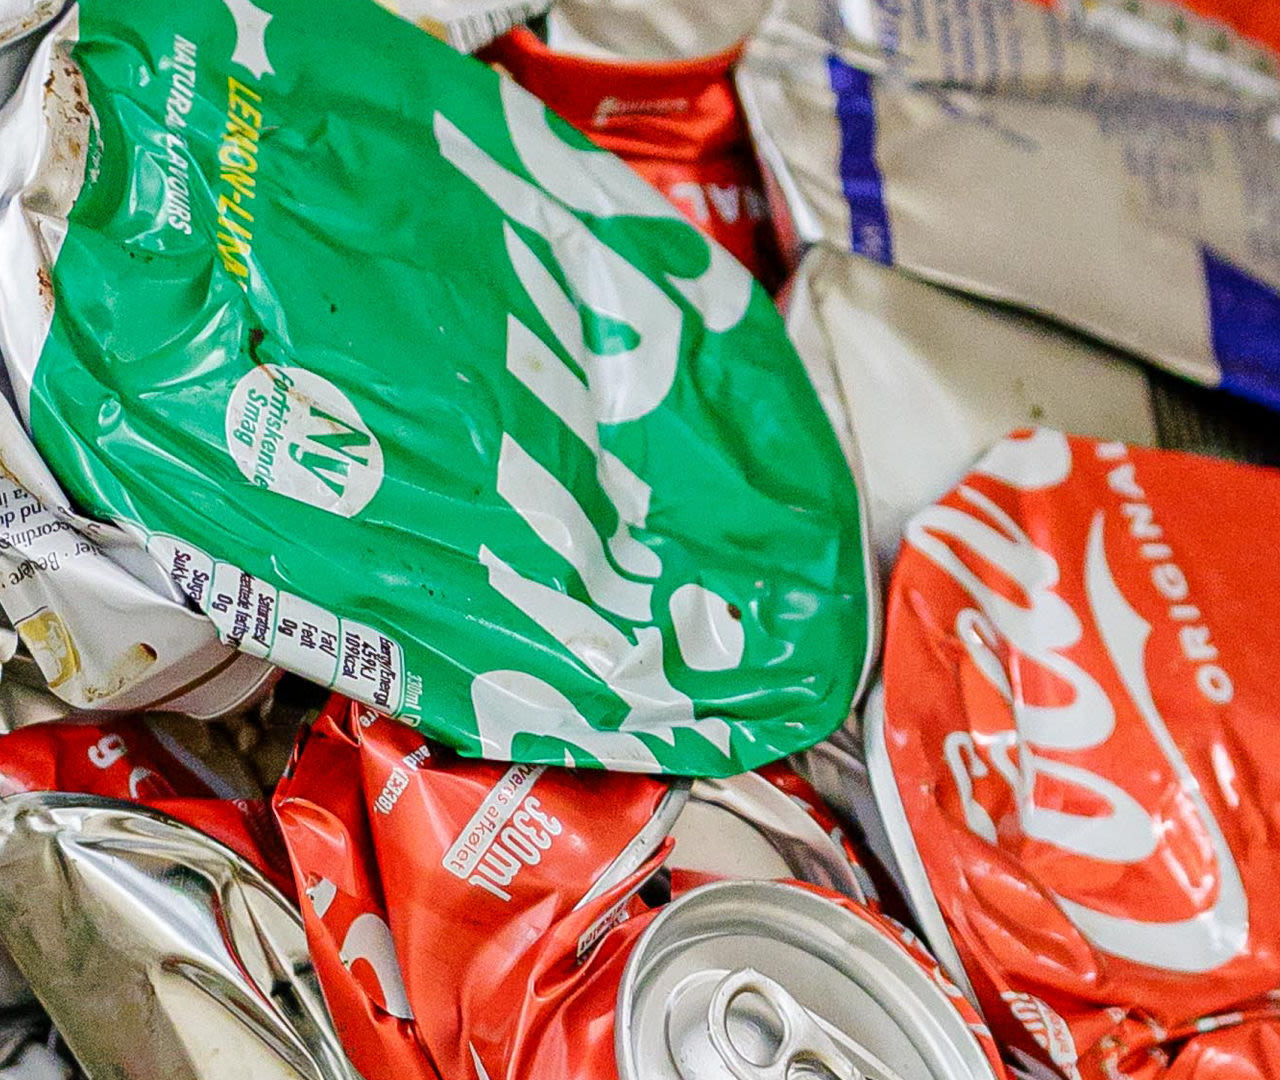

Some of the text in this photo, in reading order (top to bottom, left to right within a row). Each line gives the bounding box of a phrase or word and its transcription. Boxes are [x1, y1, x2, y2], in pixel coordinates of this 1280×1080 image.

[216, 76, 267, 280] LEMON-LIM
[233, 390, 265, 446] Smag
[288, 407, 370, 497] Ny
[299, 622, 316, 649] Fedt
[320, 631, 335, 657] Fat/
[342, 631, 358, 677] 109kcal
[450, 805, 501, 871] afkølet
[468, 796, 563, 902] 330ml
